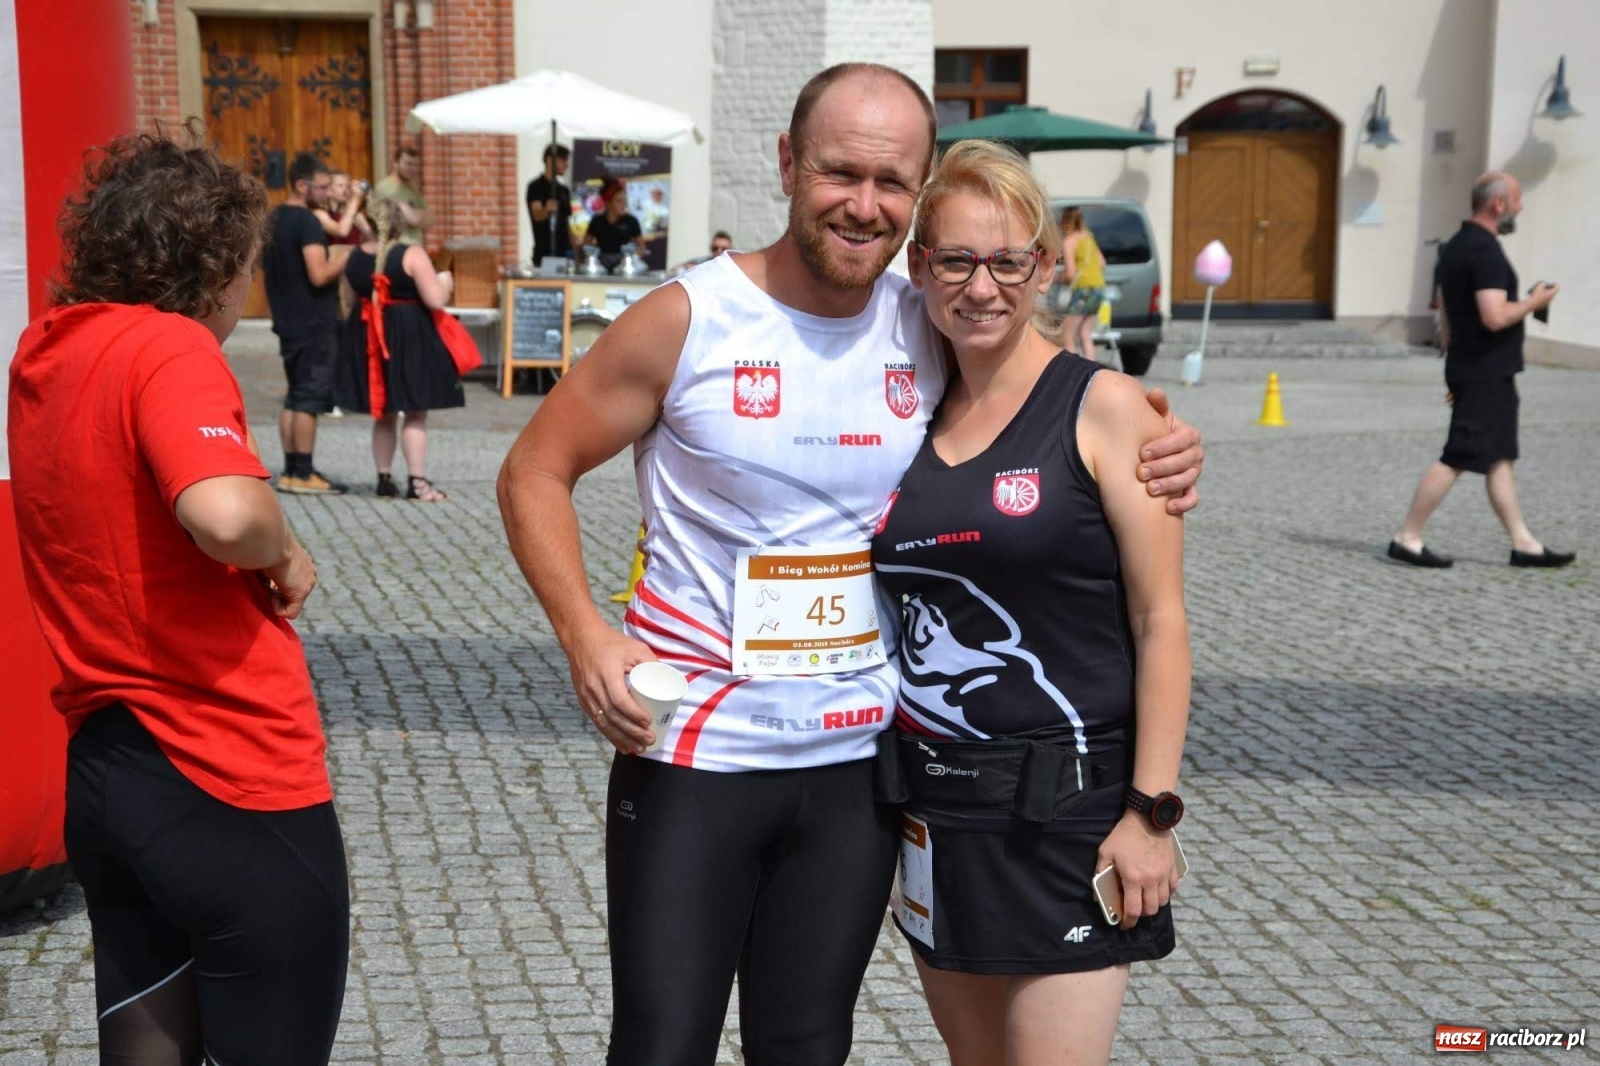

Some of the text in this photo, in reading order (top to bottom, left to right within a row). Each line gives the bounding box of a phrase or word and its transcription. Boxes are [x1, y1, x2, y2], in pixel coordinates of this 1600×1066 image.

[735, 360, 780, 368] POLSKA
[884, 362, 916, 371] RACIBÓRZ
[995, 467, 1040, 478] RACIBÓRZ
[778, 565, 803, 576] Bieg
[807, 563, 840, 574] Wokół
[805, 594, 846, 626] 45
[946, 765, 980, 778] Kalenji
[1063, 925, 1093, 943] 4F
